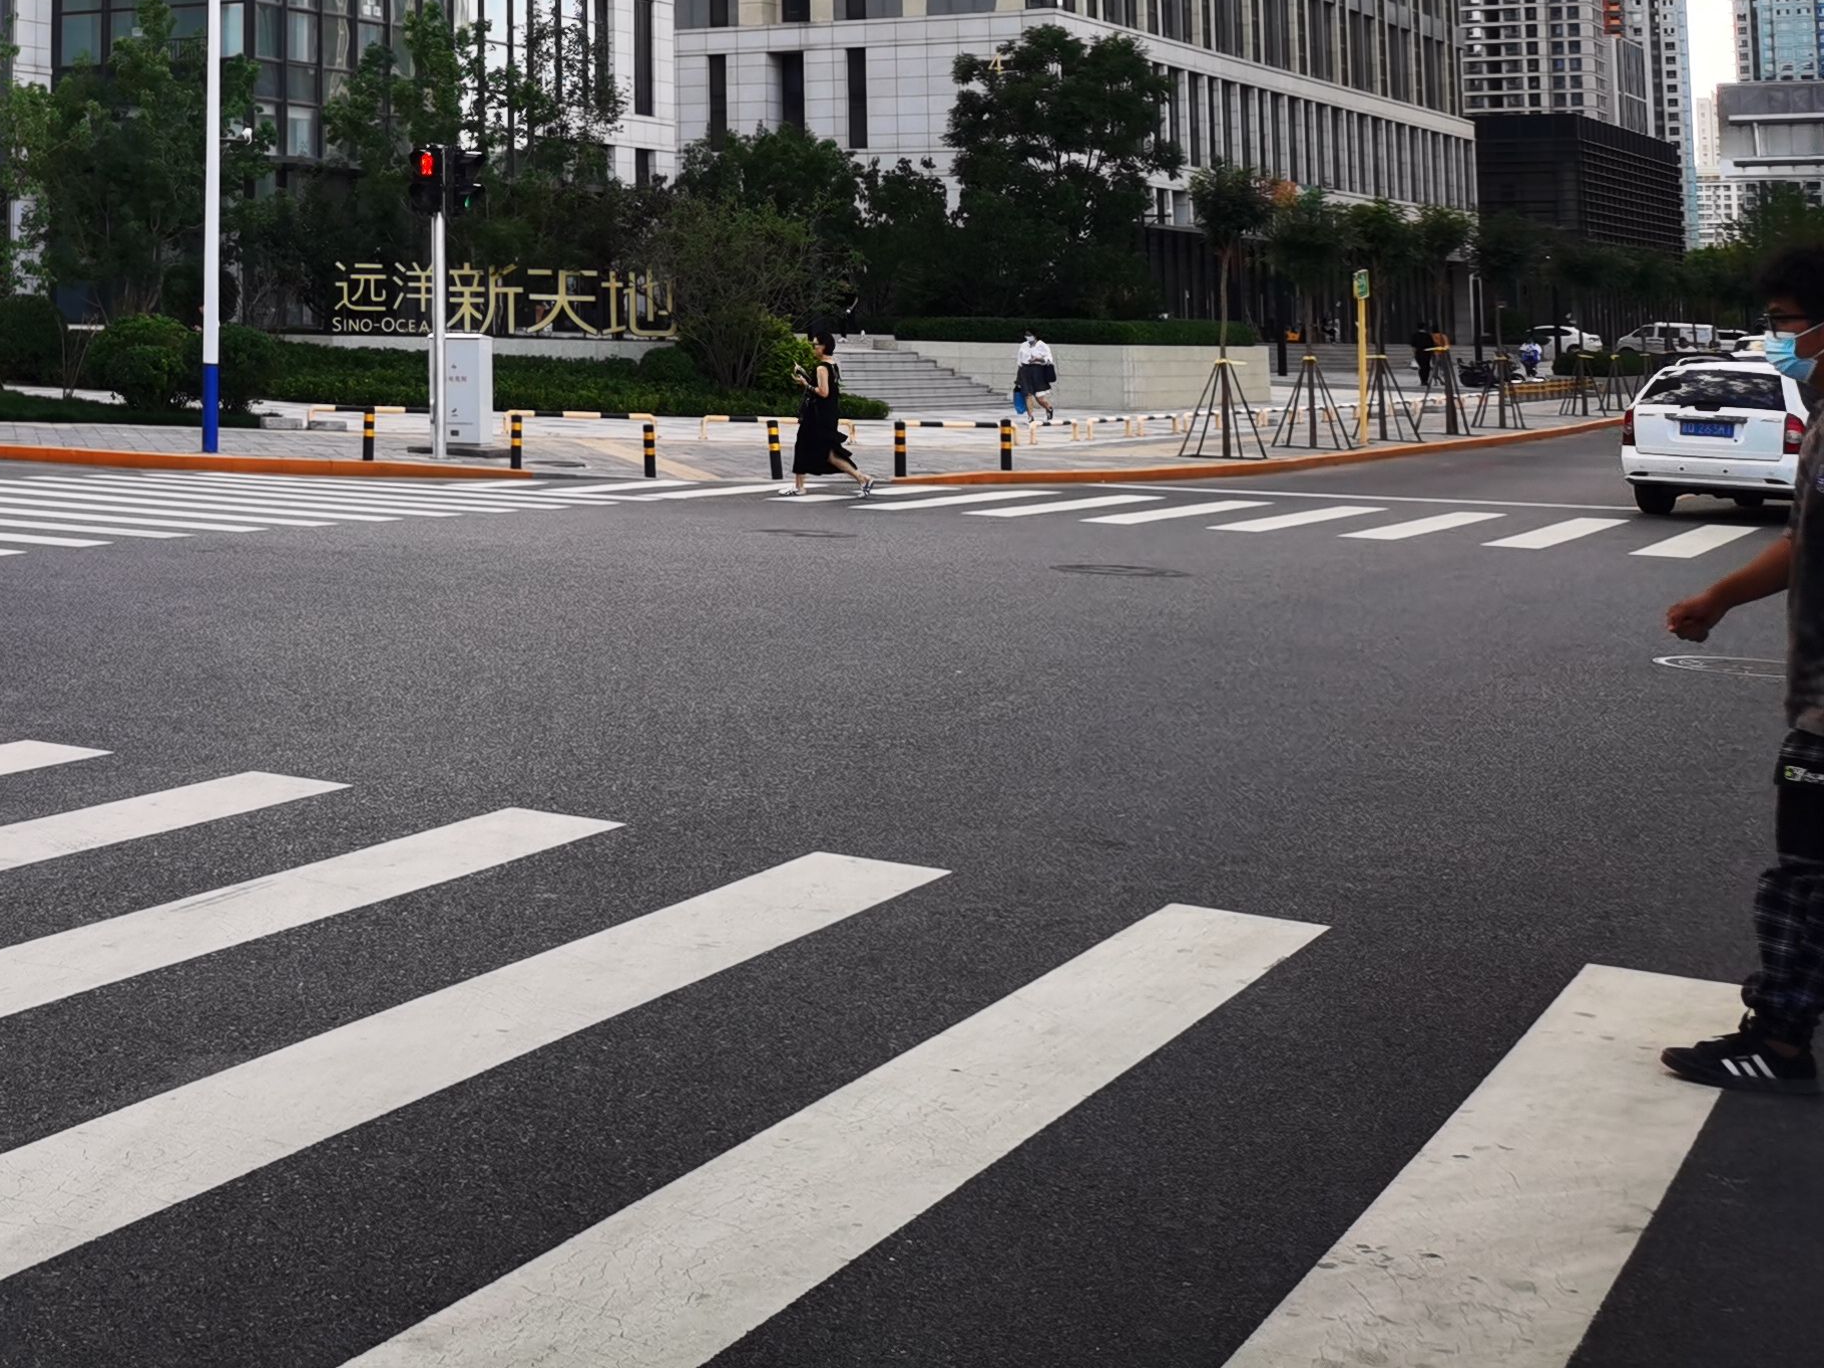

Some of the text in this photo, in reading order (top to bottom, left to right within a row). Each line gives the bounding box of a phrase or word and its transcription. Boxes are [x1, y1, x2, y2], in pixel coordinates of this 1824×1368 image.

[334, 261, 677, 338] 远洋新天地
[331, 316, 433, 333] SINO-OCEA
